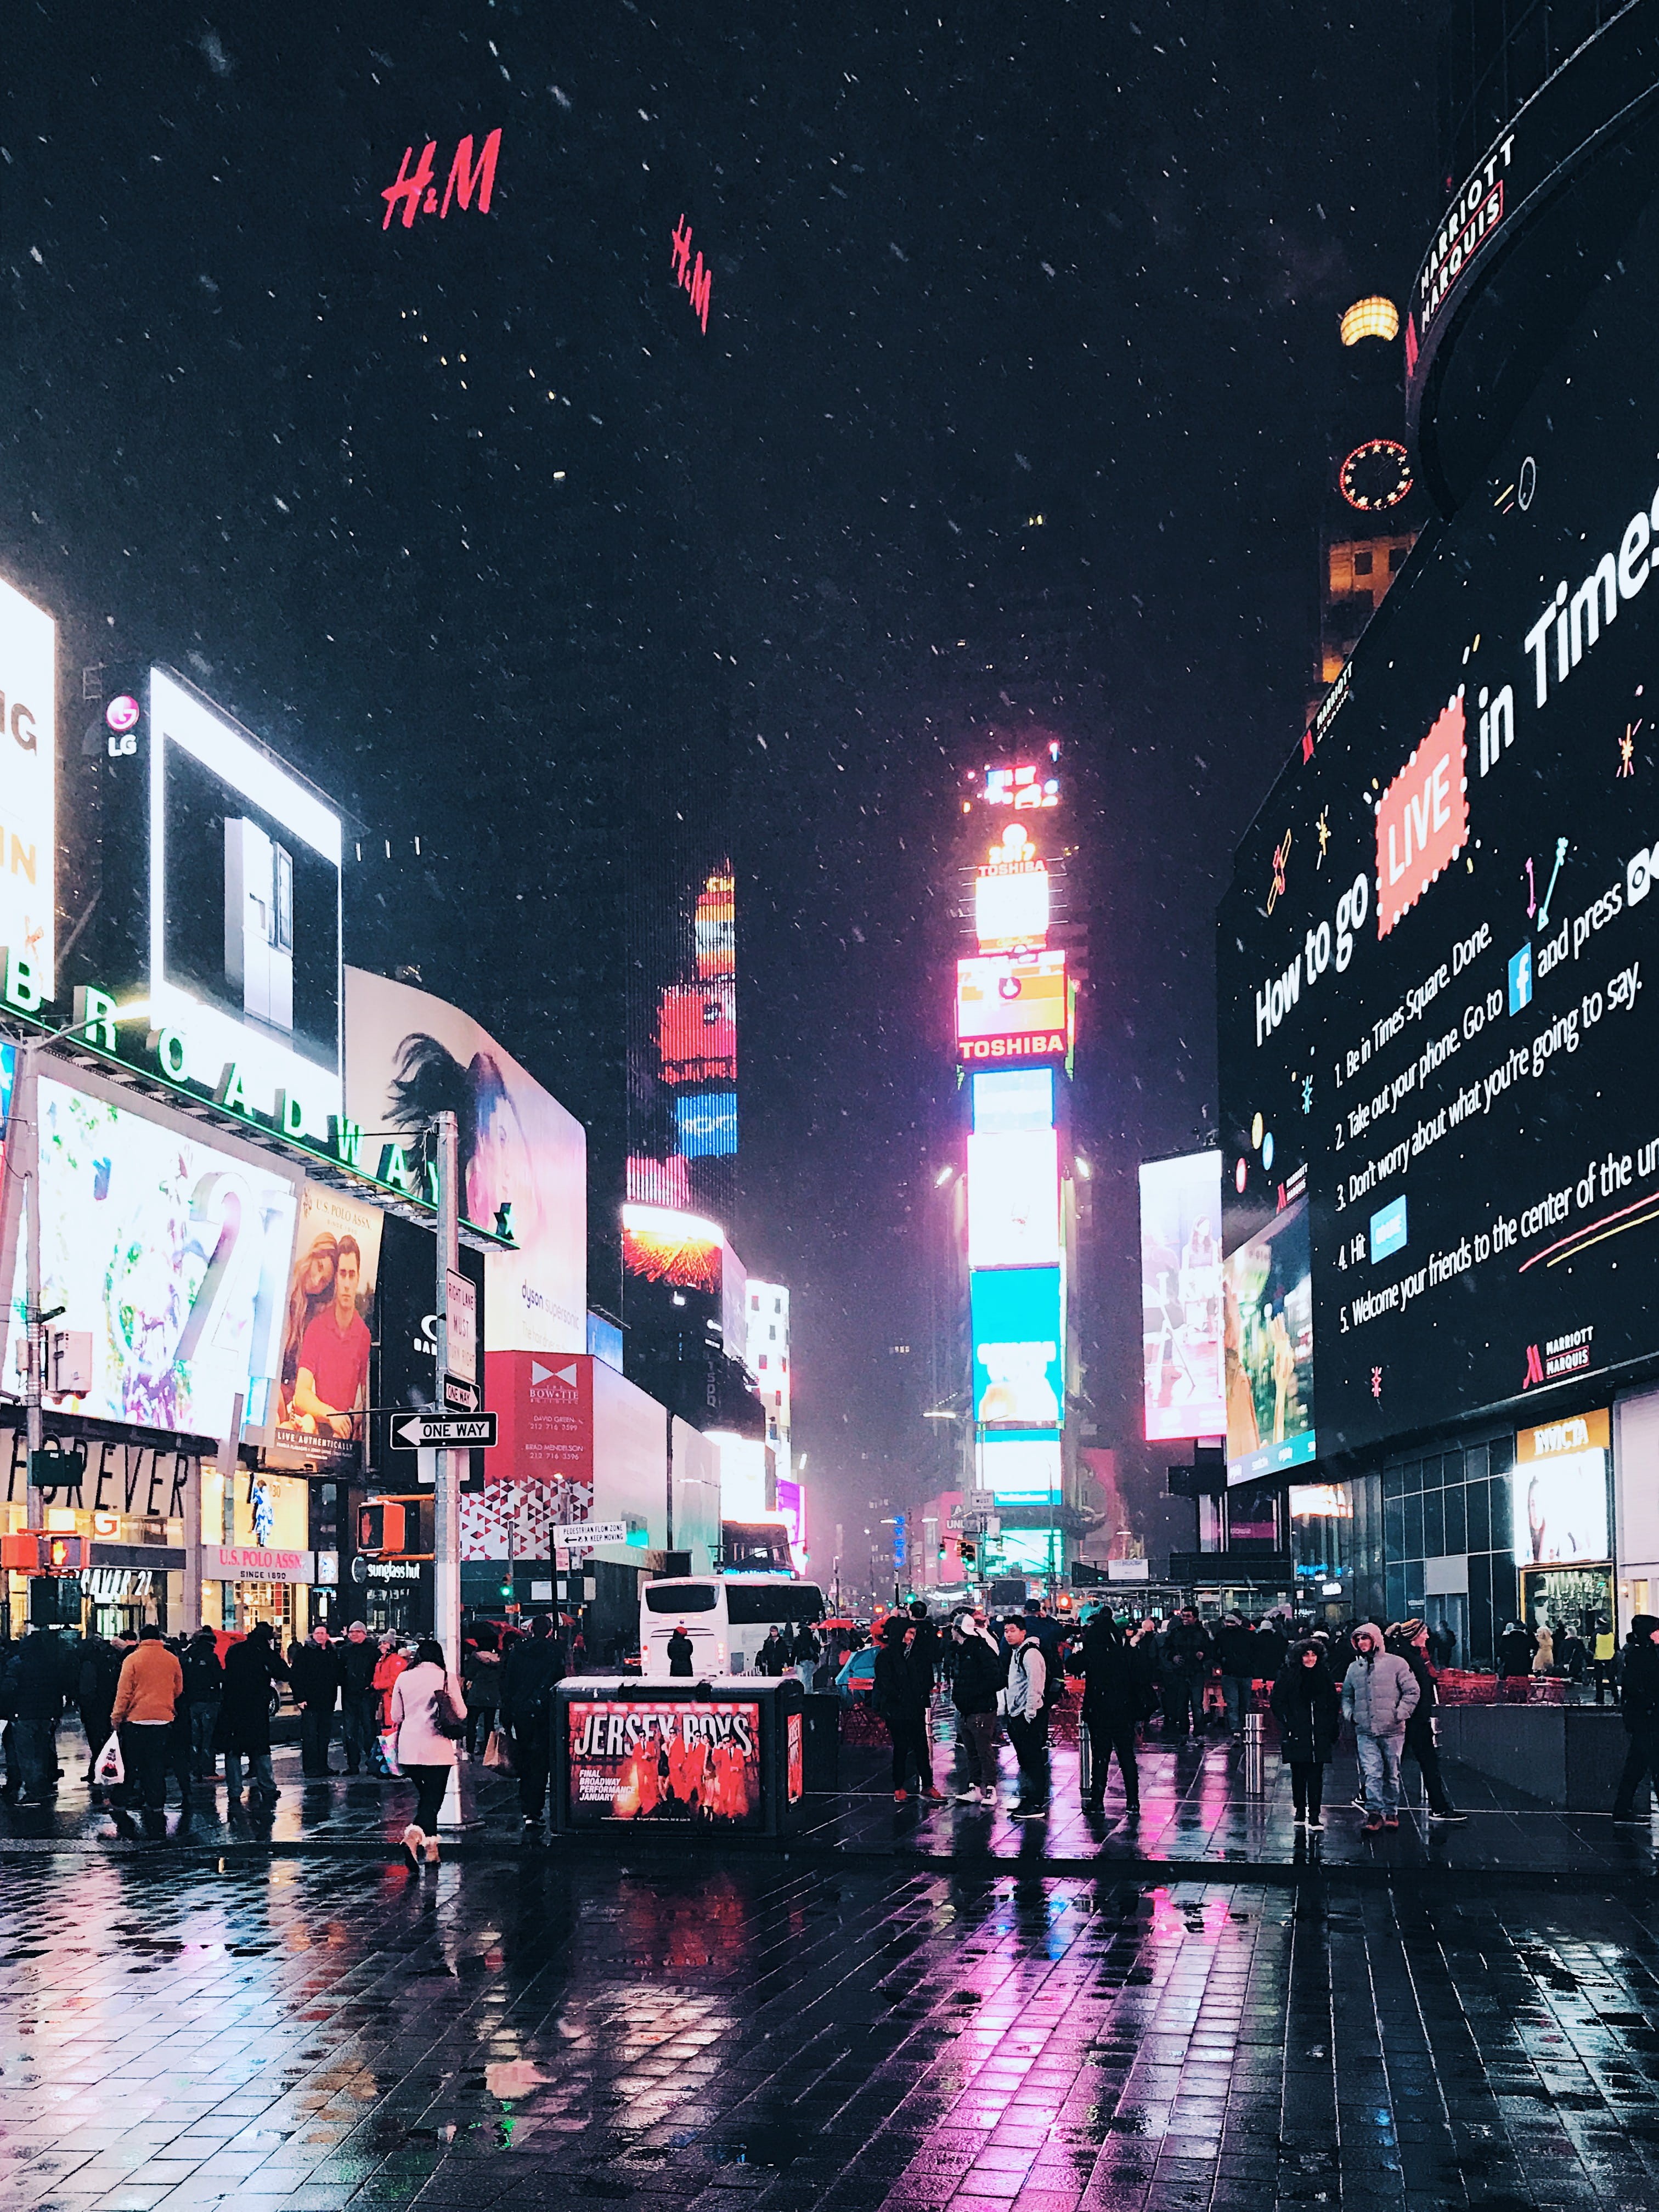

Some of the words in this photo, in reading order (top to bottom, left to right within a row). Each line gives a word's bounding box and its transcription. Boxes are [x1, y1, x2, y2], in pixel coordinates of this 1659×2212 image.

[381, 128, 502, 230] H&M
[1421, 134, 1514, 299] MARRIOTT
[672, 213, 712, 336] H&M
[1422, 193, 1499, 333] MARQUIS
[108, 735, 137, 757] LG
[978, 860, 1046, 877] TOSHIBA
[1256, 953, 1301, 1047] How
[1305, 921, 1330, 985] to
[1335, 872, 1368, 973] go
[1388, 753, 1451, 887] LIVE
[1479, 684, 1515, 777] in
[1334, 1063, 1343, 1088] 1.
[1347, 1050, 1360, 1079] Be
[1361, 1037, 1371, 1065] in
[1372, 1006, 1404, 1052] Times
[1406, 964, 1451, 1020] Square.
[1453, 922, 1493, 976] Done.
[1347, 1103, 1370, 1139] Take
[1371, 1084, 1390, 1120] out
[1391, 1063, 1418, 1114] your
[1419, 1028, 1462, 1090] phone.
[1463, 1006, 1486, 1040] Go
[1487, 989, 1503, 1022] to
[1538, 917, 1569, 978] and
[1573, 882, 1623, 960] press
[959, 1034, 1064, 1059] TOSHIBA
[1349, 1160, 1377, 1203] Don't
[1378, 1139, 1410, 1174] worry
[1412, 1120, 1447, 1156] about
[1448, 1080, 1482, 1128] what
[1483, 1048, 1530, 1115] you're
[1533, 1009, 1579, 1077] going
[1582, 992, 1603, 1029] to
[1607, 961, 1643, 1011] say.
[331, 1204, 351, 1222] POLO
[352, 1214, 372, 1231] ASSN.
[1340, 1306, 1350, 1334] 5.
[1352, 1290, 1400, 1327] Welcome
[1400, 1267, 1427, 1312] your
[1429, 1237, 1472, 1287] friends
[1474, 1234, 1490, 1263] to
[1492, 1215, 1517, 1254] the
[1521, 1186, 1573, 1239] center
[1576, 1161, 1597, 1209] of
[1600, 1152, 1633, 1197] the
[1351, 1233, 1367, 1265] Hit
[462, 1290, 473, 1311] LANE
[522, 1278, 544, 1309] dyson
[453, 1313, 469, 1339] MUST
[1546, 1325, 1594, 1356] MARRIOTT
[1546, 1348, 1589, 1376] MARQUIS
[448, 1385, 459, 1402] ONE
[459, 1390, 471, 1405] WAY
[277, 1431, 295, 1442] LIVE
[298, 1435, 353, 1451] AUTHENTICALLY
[423, 1424, 451, 1437] ONE
[456, 1423, 486, 1437] WAY
[1534, 1419, 1589, 1455] INVICTA
[563, 1527, 594, 1535] PEDESTRIAN
[610, 1524, 623, 1532] ZONE
[604, 1533, 624, 1541] MOVING
[219, 1549, 240, 1566] U.S.
[242, 1550, 273, 1568] POLO
[367, 1560, 405, 1583] sunglass
[405, 1560, 420, 1579] hut
[134, 1570, 153, 1596] 21
[240, 1571, 264, 1579] SINCE
[574, 1713, 675, 1756] JERSEY
[682, 1713, 752, 1757] BOYS
[579, 1769, 601, 1778] FINAL
[579, 1778, 621, 1786] BROADWAY
[579, 1785, 636, 1794] PERFORMANCE
[579, 1793, 614, 1802] JANUARY
